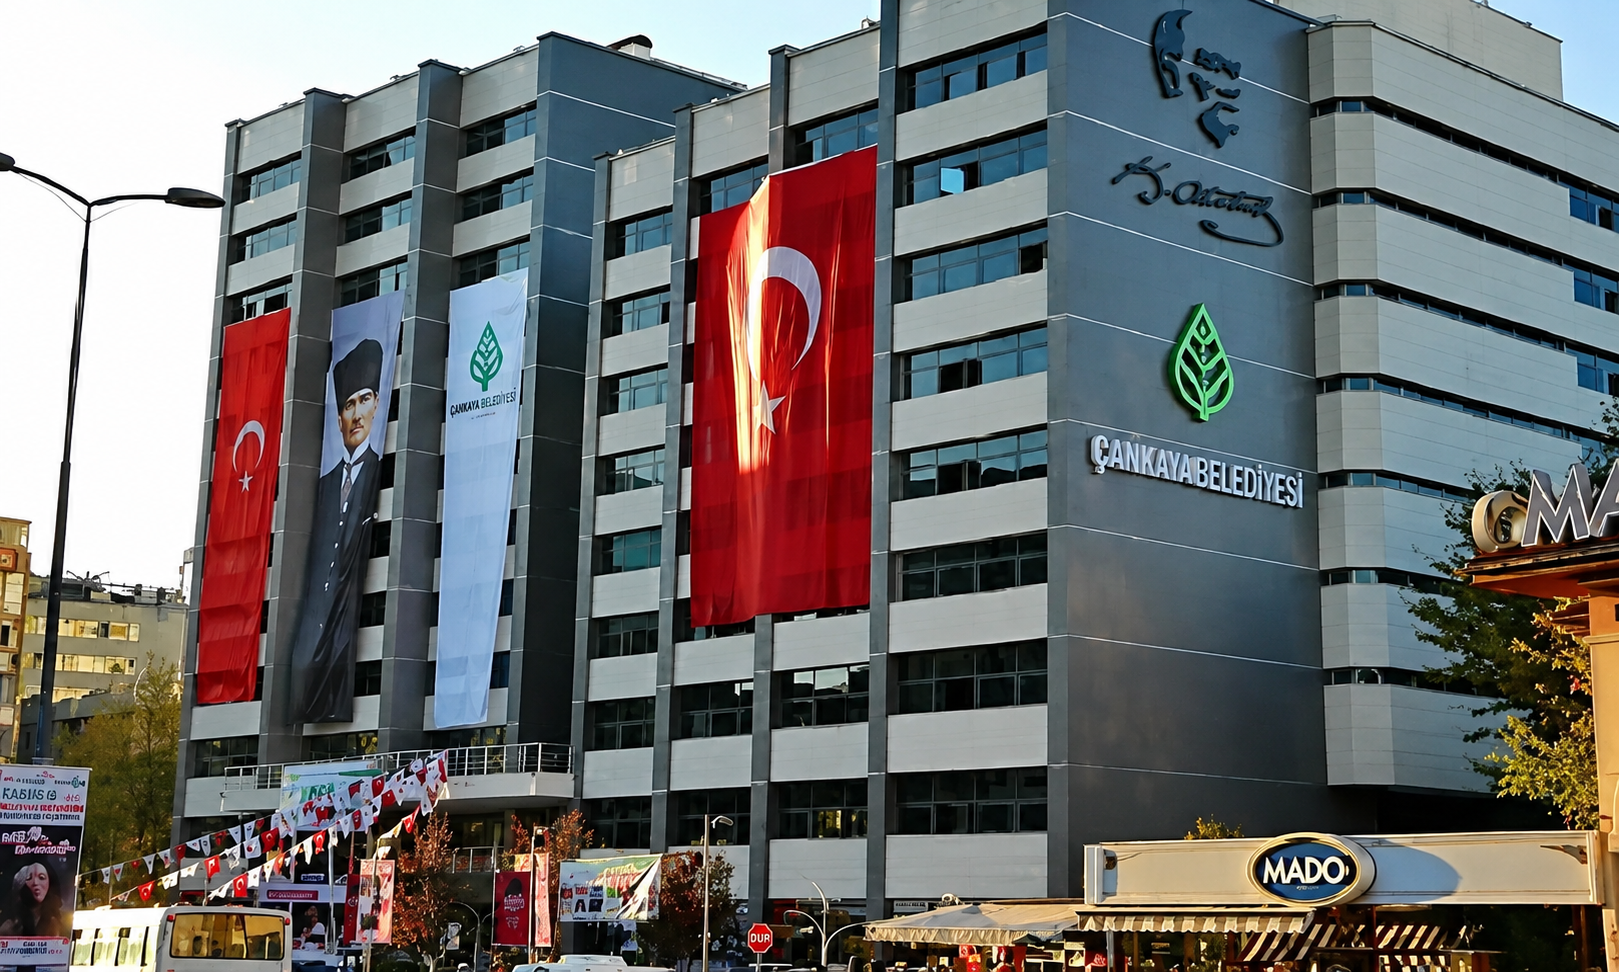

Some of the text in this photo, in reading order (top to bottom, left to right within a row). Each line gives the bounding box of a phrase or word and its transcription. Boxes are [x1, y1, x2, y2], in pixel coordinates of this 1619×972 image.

[450, 399, 480, 418] ÇANKAYA
[480, 387, 517, 409] BELEDİYESİ
[1263, 856, 1345, 885] MADO
[750, 933, 770, 943] DUR
